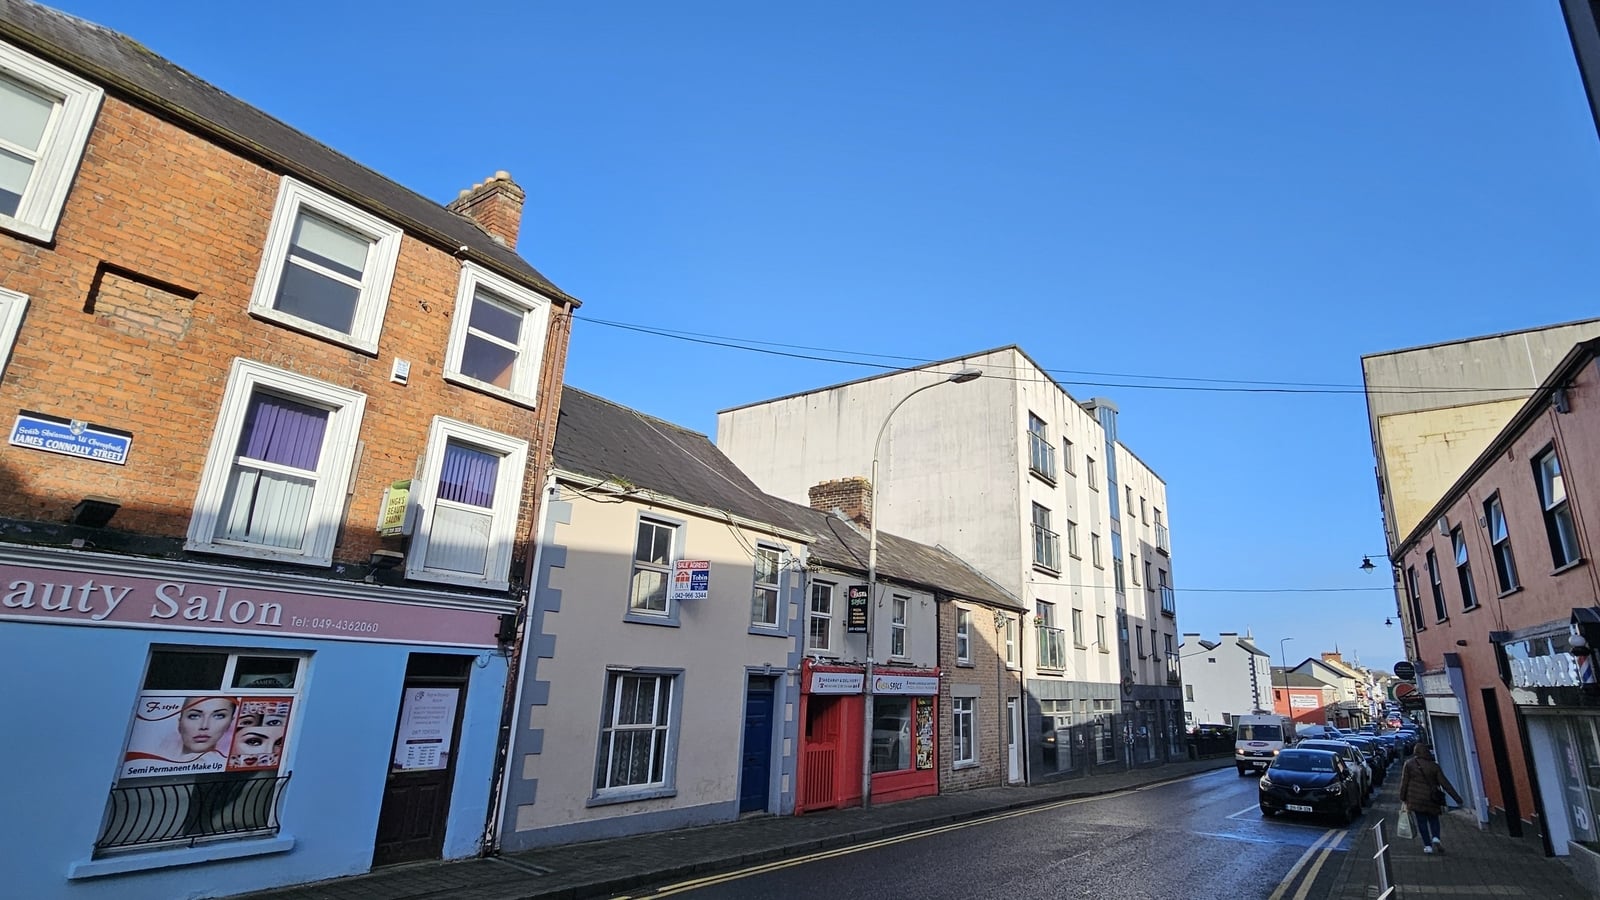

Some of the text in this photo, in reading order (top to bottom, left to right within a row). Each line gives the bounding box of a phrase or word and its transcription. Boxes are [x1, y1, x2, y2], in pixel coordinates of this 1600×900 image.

[14, 434, 122, 461] JAMES CONNOLLY STREET
[385, 514, 402, 525] SALON
[692, 573, 708, 581] Tobin
[150, 582, 283, 627] Salon
[291, 616, 310, 628] Tel:
[312, 617, 379, 633] 049-4362060
[128, 762, 223, 775] Semi Permanent Make Up
